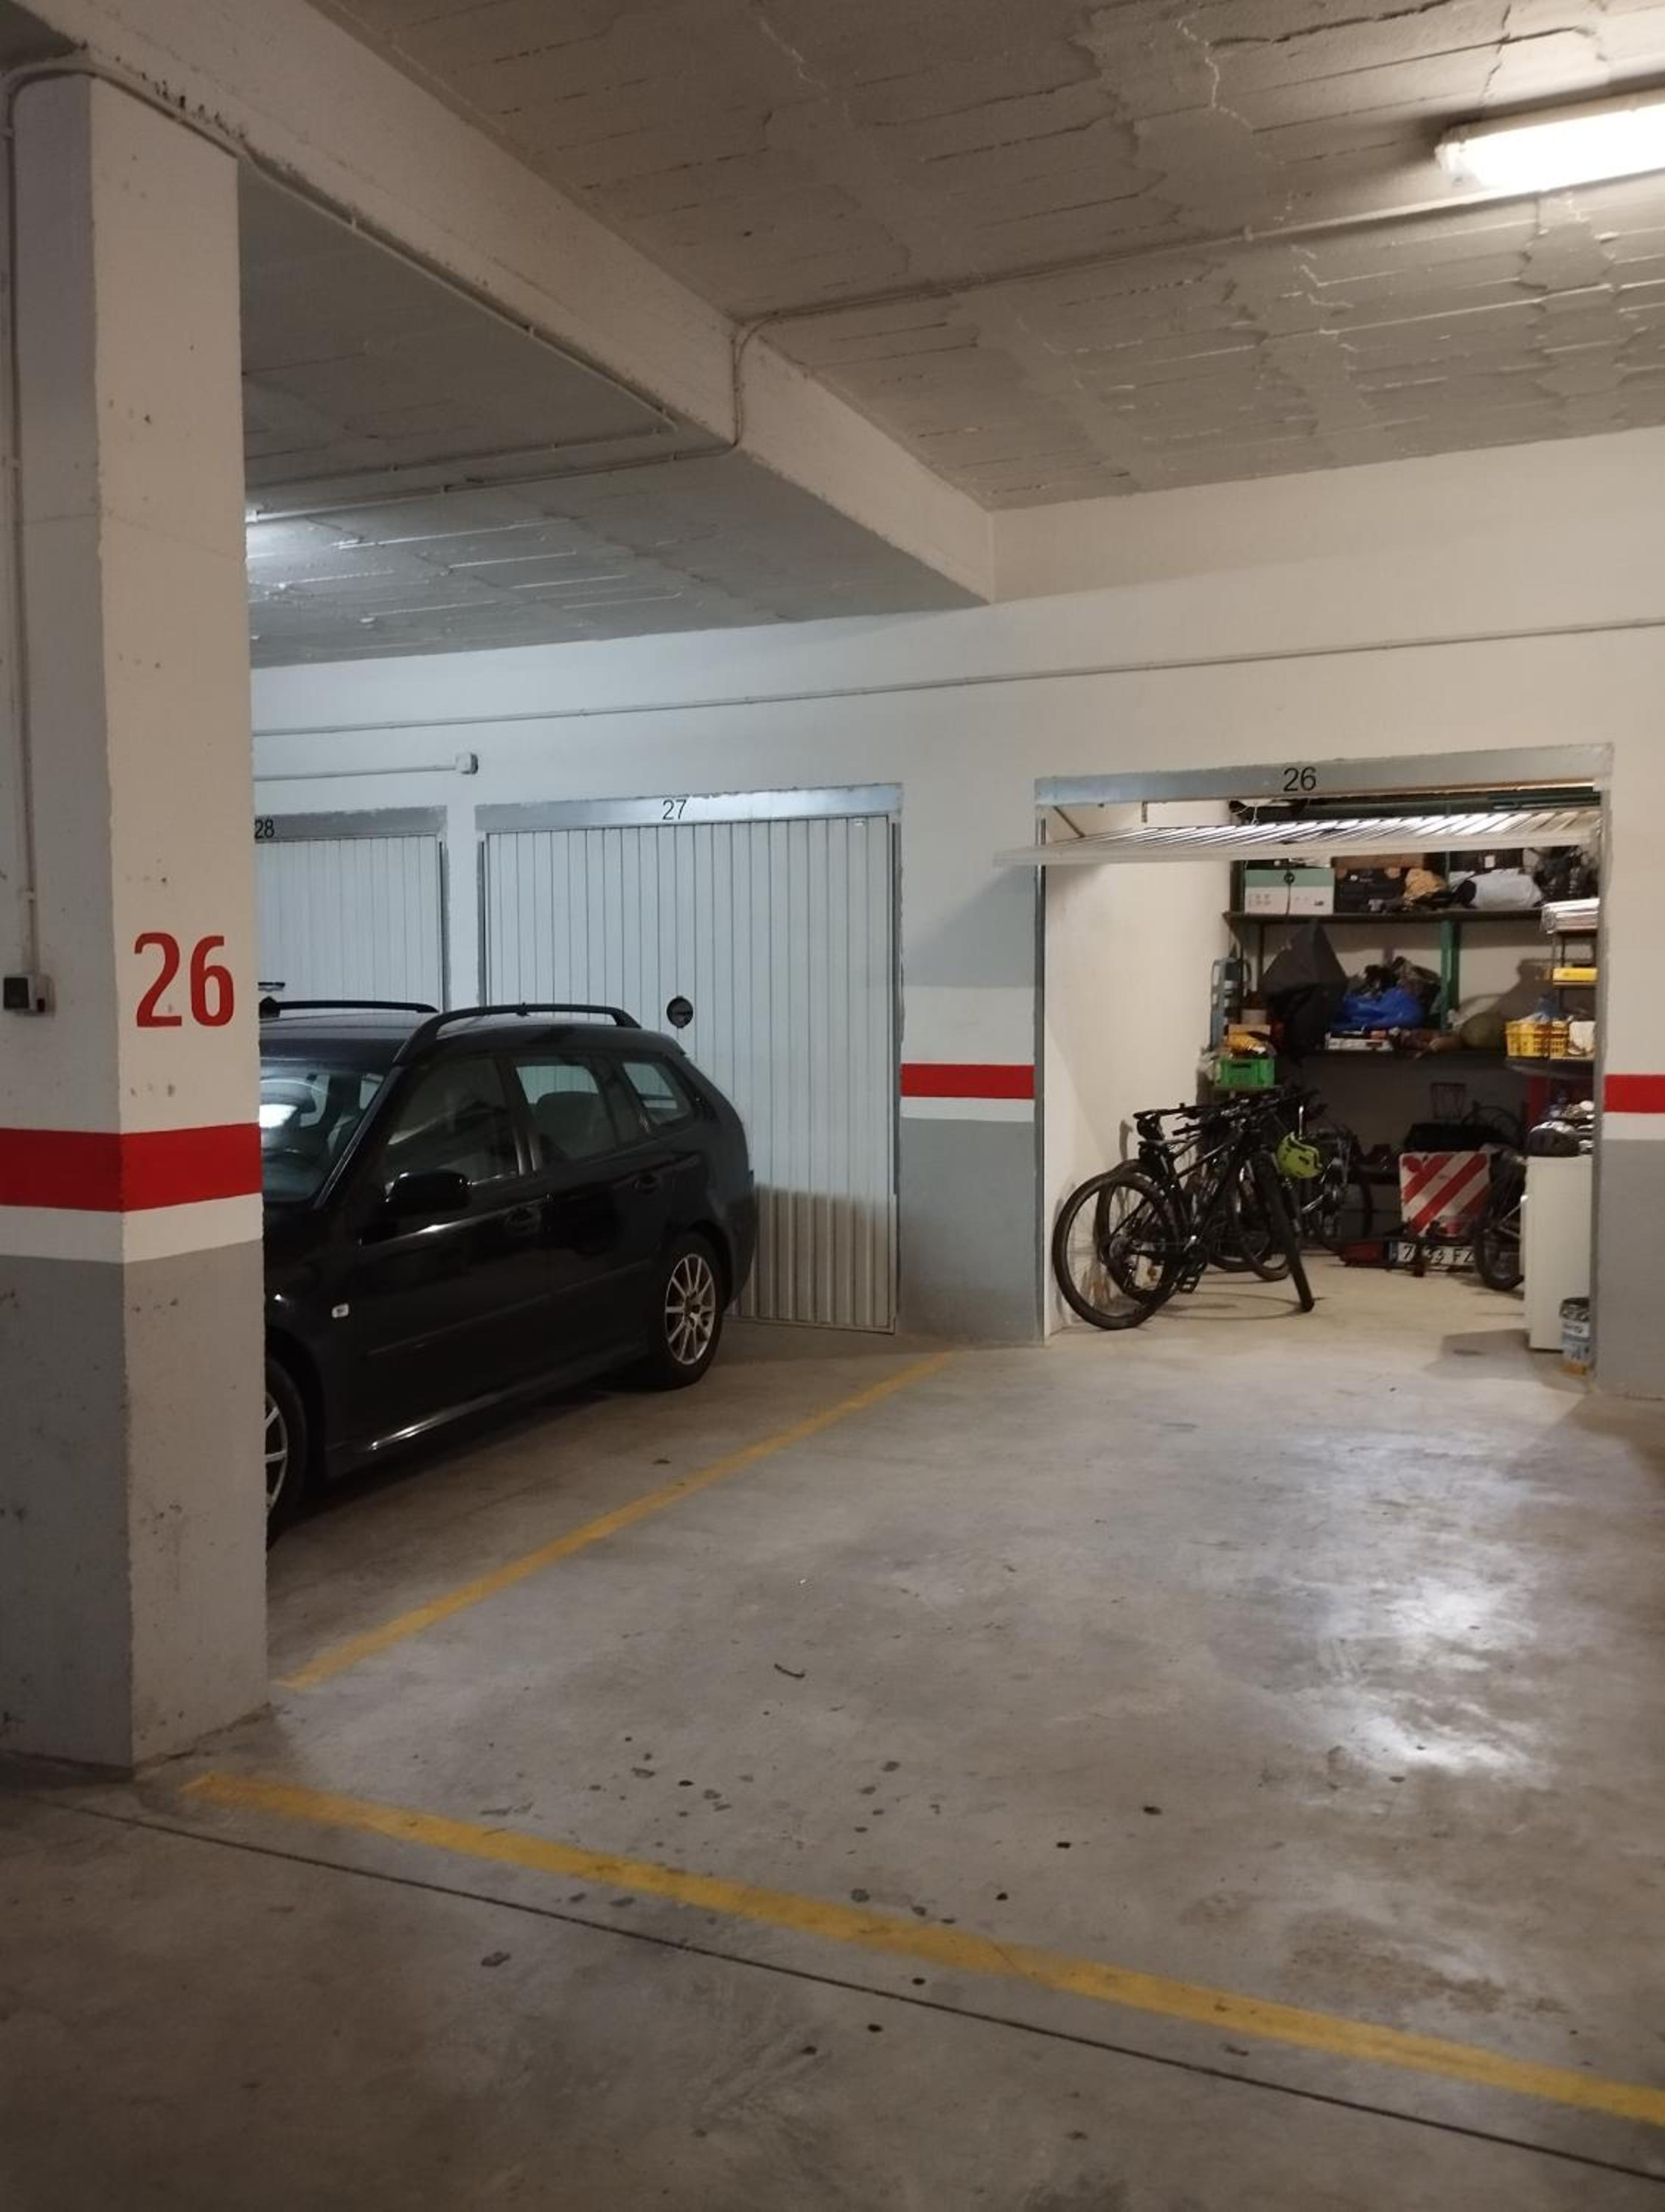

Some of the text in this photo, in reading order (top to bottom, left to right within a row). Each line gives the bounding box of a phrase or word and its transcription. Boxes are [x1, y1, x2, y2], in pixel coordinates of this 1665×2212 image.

[1284, 767, 1316, 791] 26
[662, 799, 686, 821] 27
[254, 818, 274, 839] 28
[134, 932, 234, 1027] 26
